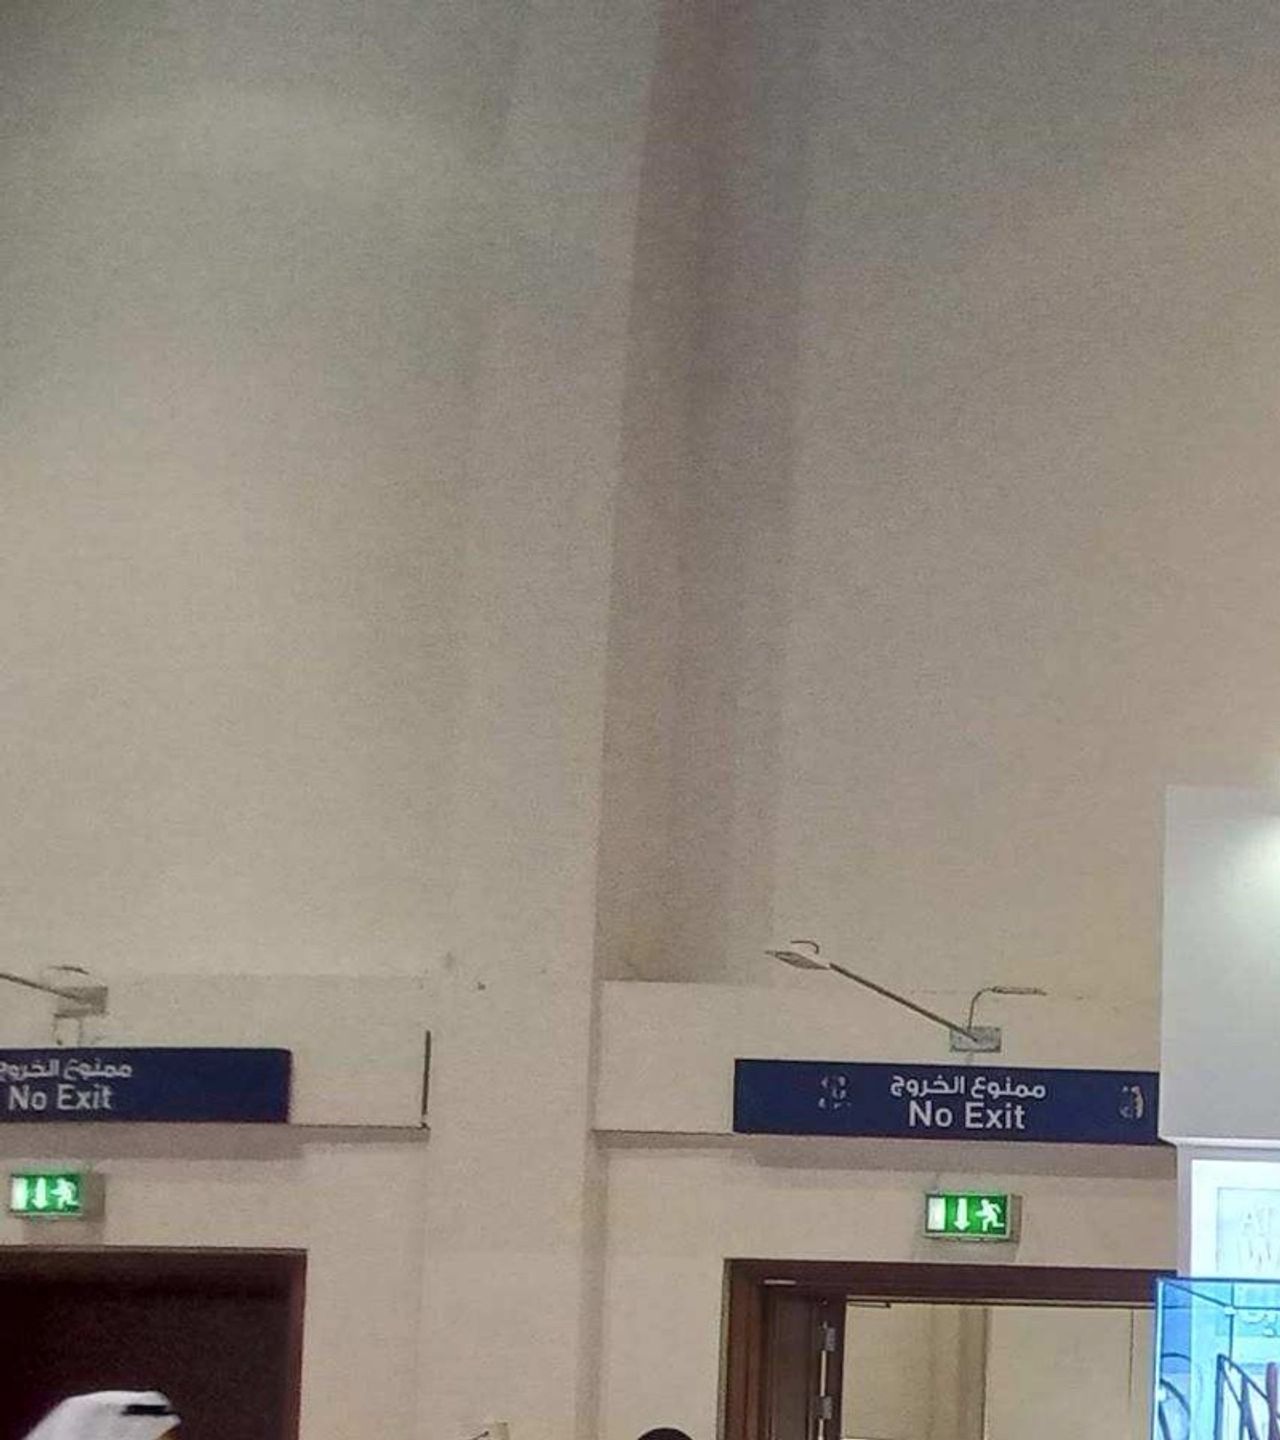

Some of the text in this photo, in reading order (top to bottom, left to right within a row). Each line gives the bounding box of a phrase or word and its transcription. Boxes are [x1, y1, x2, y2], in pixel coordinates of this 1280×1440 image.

[64, 1058, 133, 1081] ممنوع
[8, 1083, 112, 1111] No Exit
[890, 1075, 1047, 1099] ممنوع الخروج
[908, 1101, 1026, 1130] No Exit
